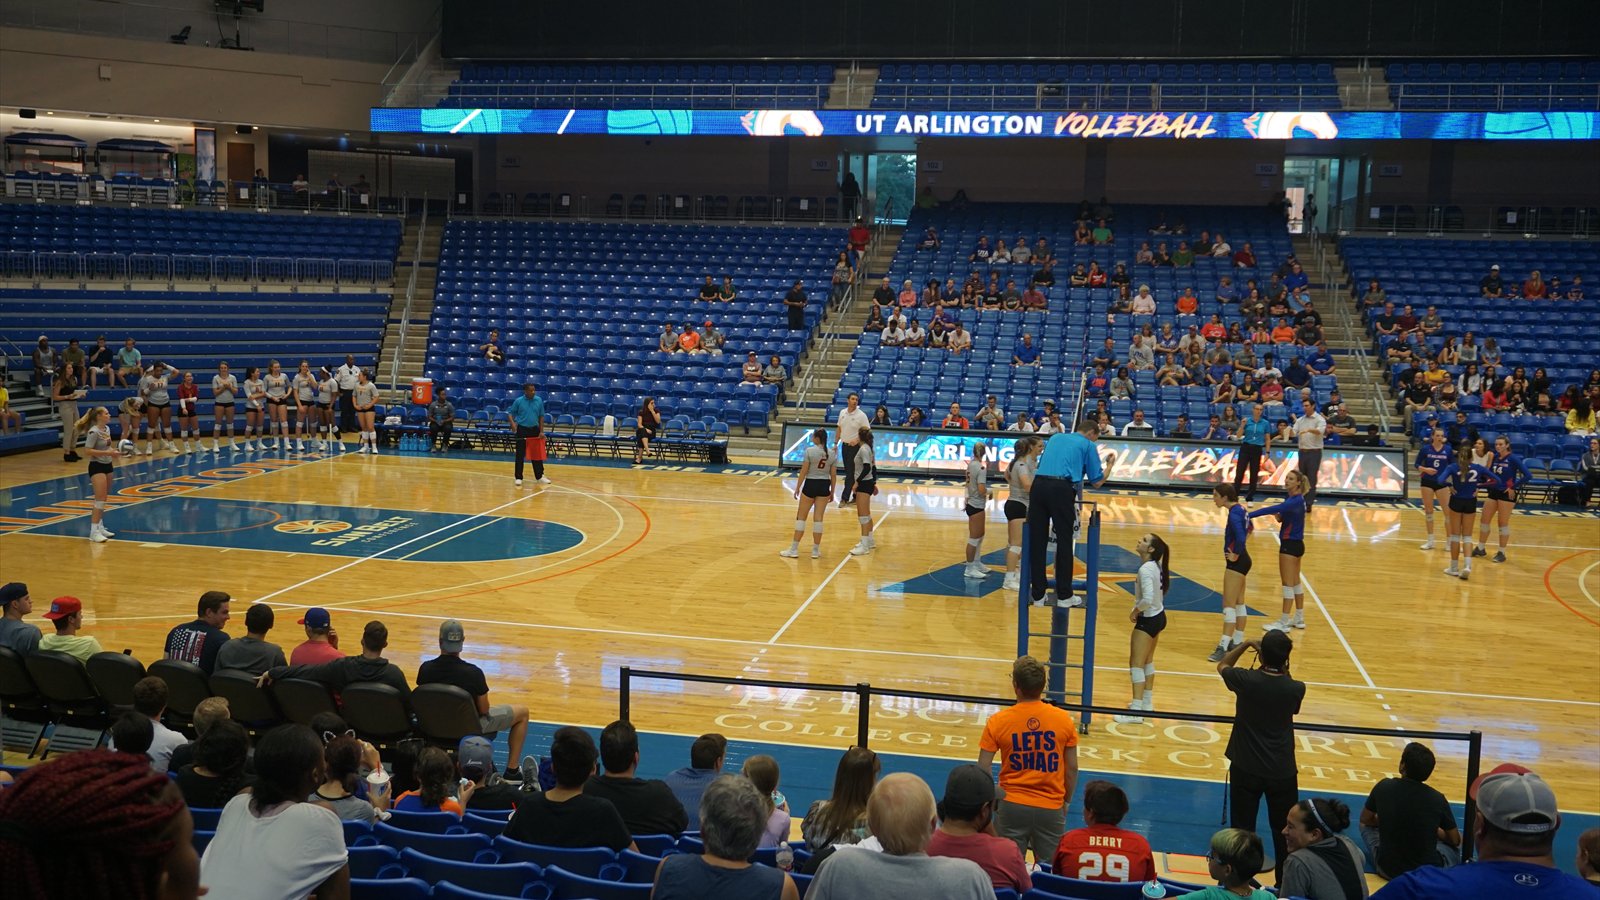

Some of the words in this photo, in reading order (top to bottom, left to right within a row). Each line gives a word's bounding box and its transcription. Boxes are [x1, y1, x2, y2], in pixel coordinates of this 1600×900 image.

[855, 114, 886, 133] UT
[895, 114, 1043, 135] ARLINGTON
[1054, 111, 1217, 138] VOLLEYBALL
[817, 458, 828, 470] 6
[888, 441, 917, 458] UT
[1096, 443, 1273, 482] OLLEYBA
[1433, 459, 1440, 468] 6
[1492, 465, 1503, 474] 14
[714, 713, 968, 748] COLLEGE
[1012, 731, 1056, 751] LETS
[1105, 718, 1394, 760] CORT
[1009, 752, 1059, 773] SHAG
[1089, 836, 1122, 848] BERRY
[1078, 851, 1130, 882] 29
